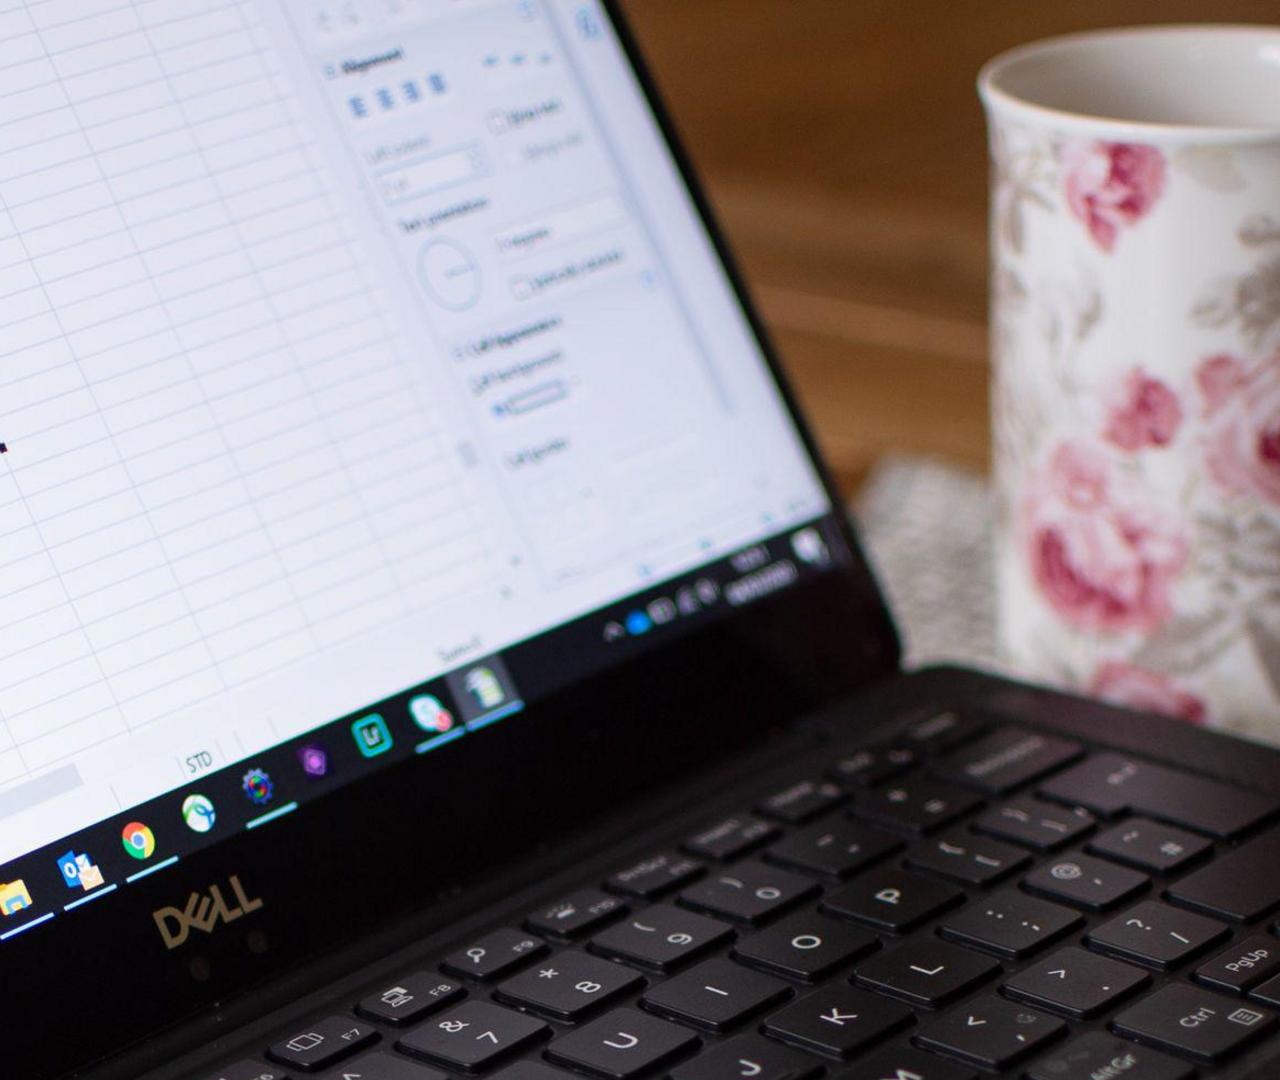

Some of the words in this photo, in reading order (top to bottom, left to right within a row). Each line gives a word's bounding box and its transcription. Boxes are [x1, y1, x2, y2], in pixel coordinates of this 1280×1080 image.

[183, 748, 214, 775] STD
[875, 887, 902, 905] P
[153, 875, 264, 950] DELL
[666, 932, 694, 946] 9
[1224, 948, 1269, 973] PgUp
[909, 964, 945, 977] L
[428, 983, 452, 999] F8
[574, 978, 602, 995] 8
[820, 1006, 859, 1026] K
[1179, 1006, 1216, 1029] Ctrl
[340, 1027, 362, 1042] F7
[438, 1018, 470, 1034] &
[475, 1030, 500, 1045] 7
[602, 1031, 639, 1050] U
[738, 1059, 762, 1077] J
